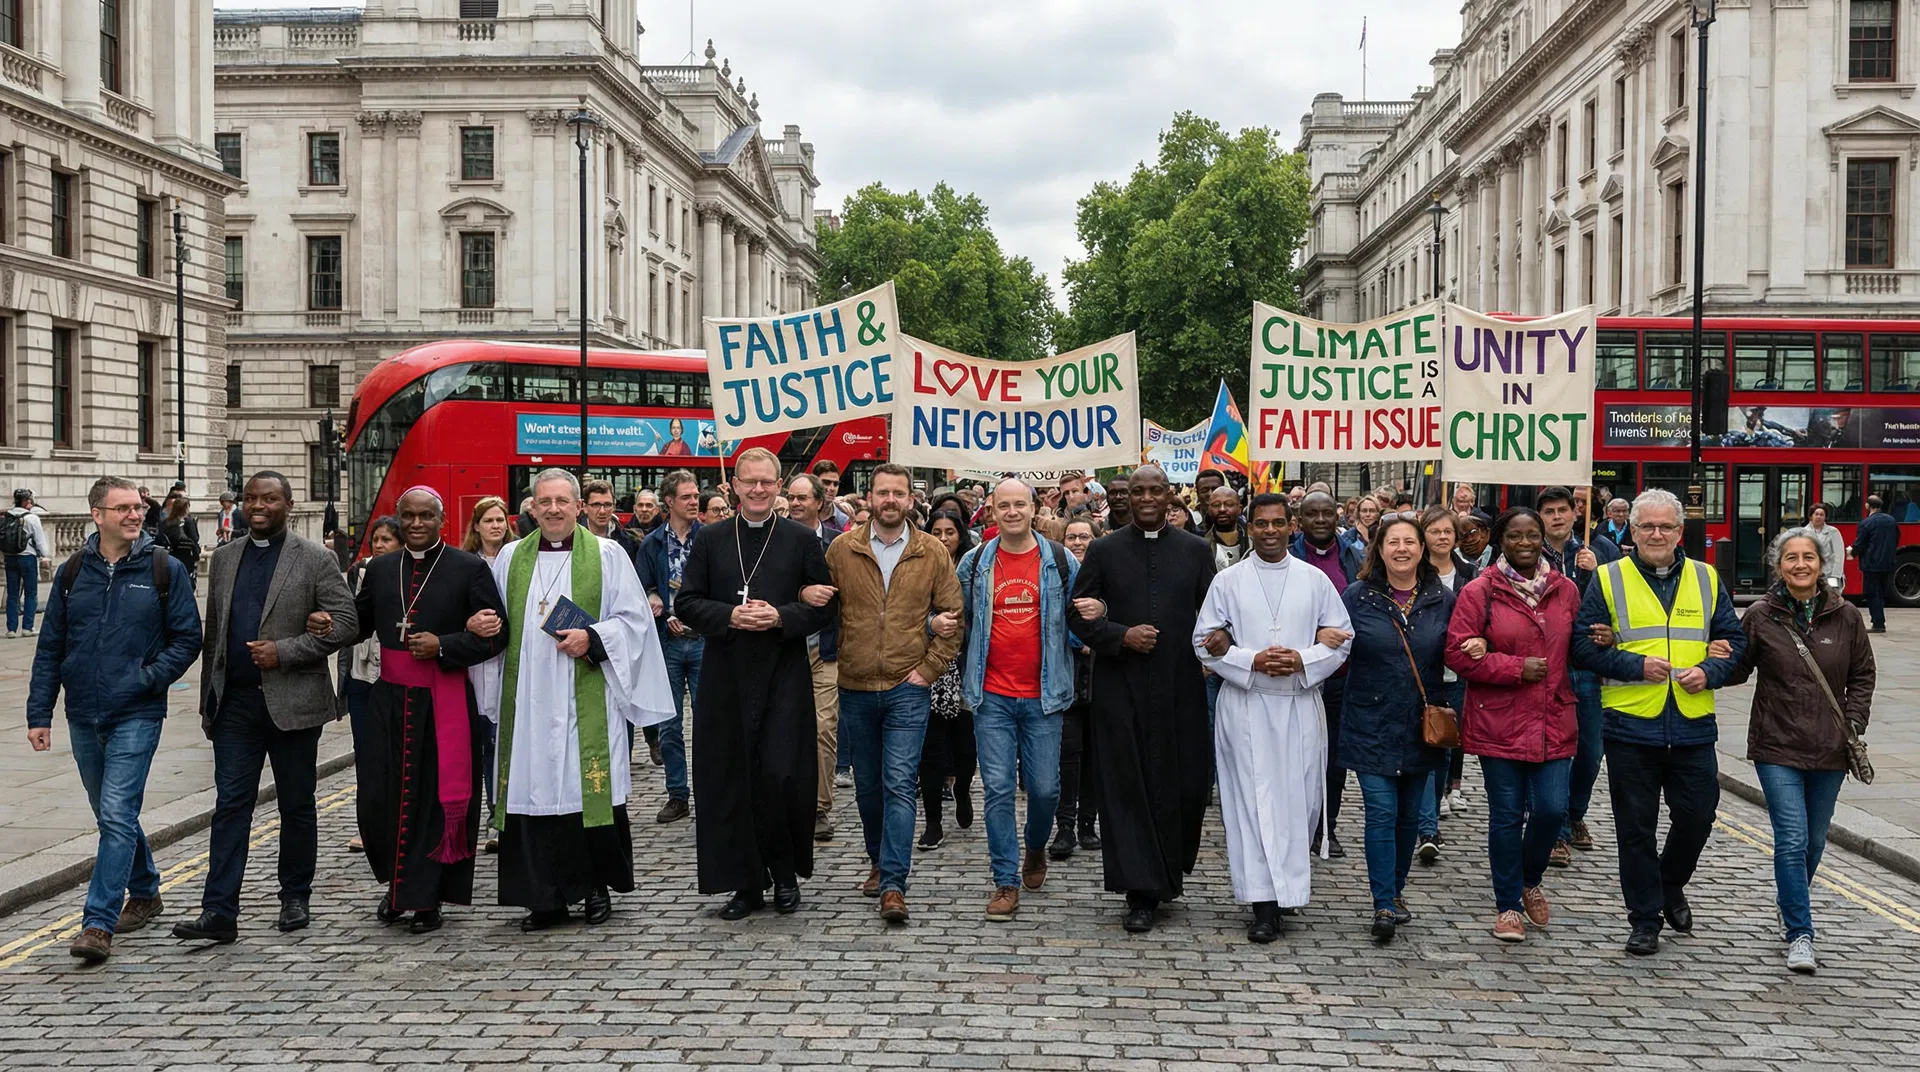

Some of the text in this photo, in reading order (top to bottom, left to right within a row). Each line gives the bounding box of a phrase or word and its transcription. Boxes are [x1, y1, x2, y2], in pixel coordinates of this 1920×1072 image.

[718, 300, 886, 371] FAITH &
[1262, 314, 1436, 360] CLIMATE
[1454, 326, 1588, 375] UNITY
[723, 354, 894, 427] JUSTICE
[1035, 353, 1124, 399] YOUR
[1259, 360, 1439, 401] JUSTICE IS
[1421, 381, 1437, 398] A
[1503, 383, 1532, 405] IN
[524, 422, 556, 434] Won't
[599, 424, 614, 436] the
[912, 405, 1122, 452] NEIGHBOUR
[1259, 406, 1442, 450] FAITH ISSUE
[1449, 411, 1587, 462] CHRIST
[1665, 411, 1678, 424] of
